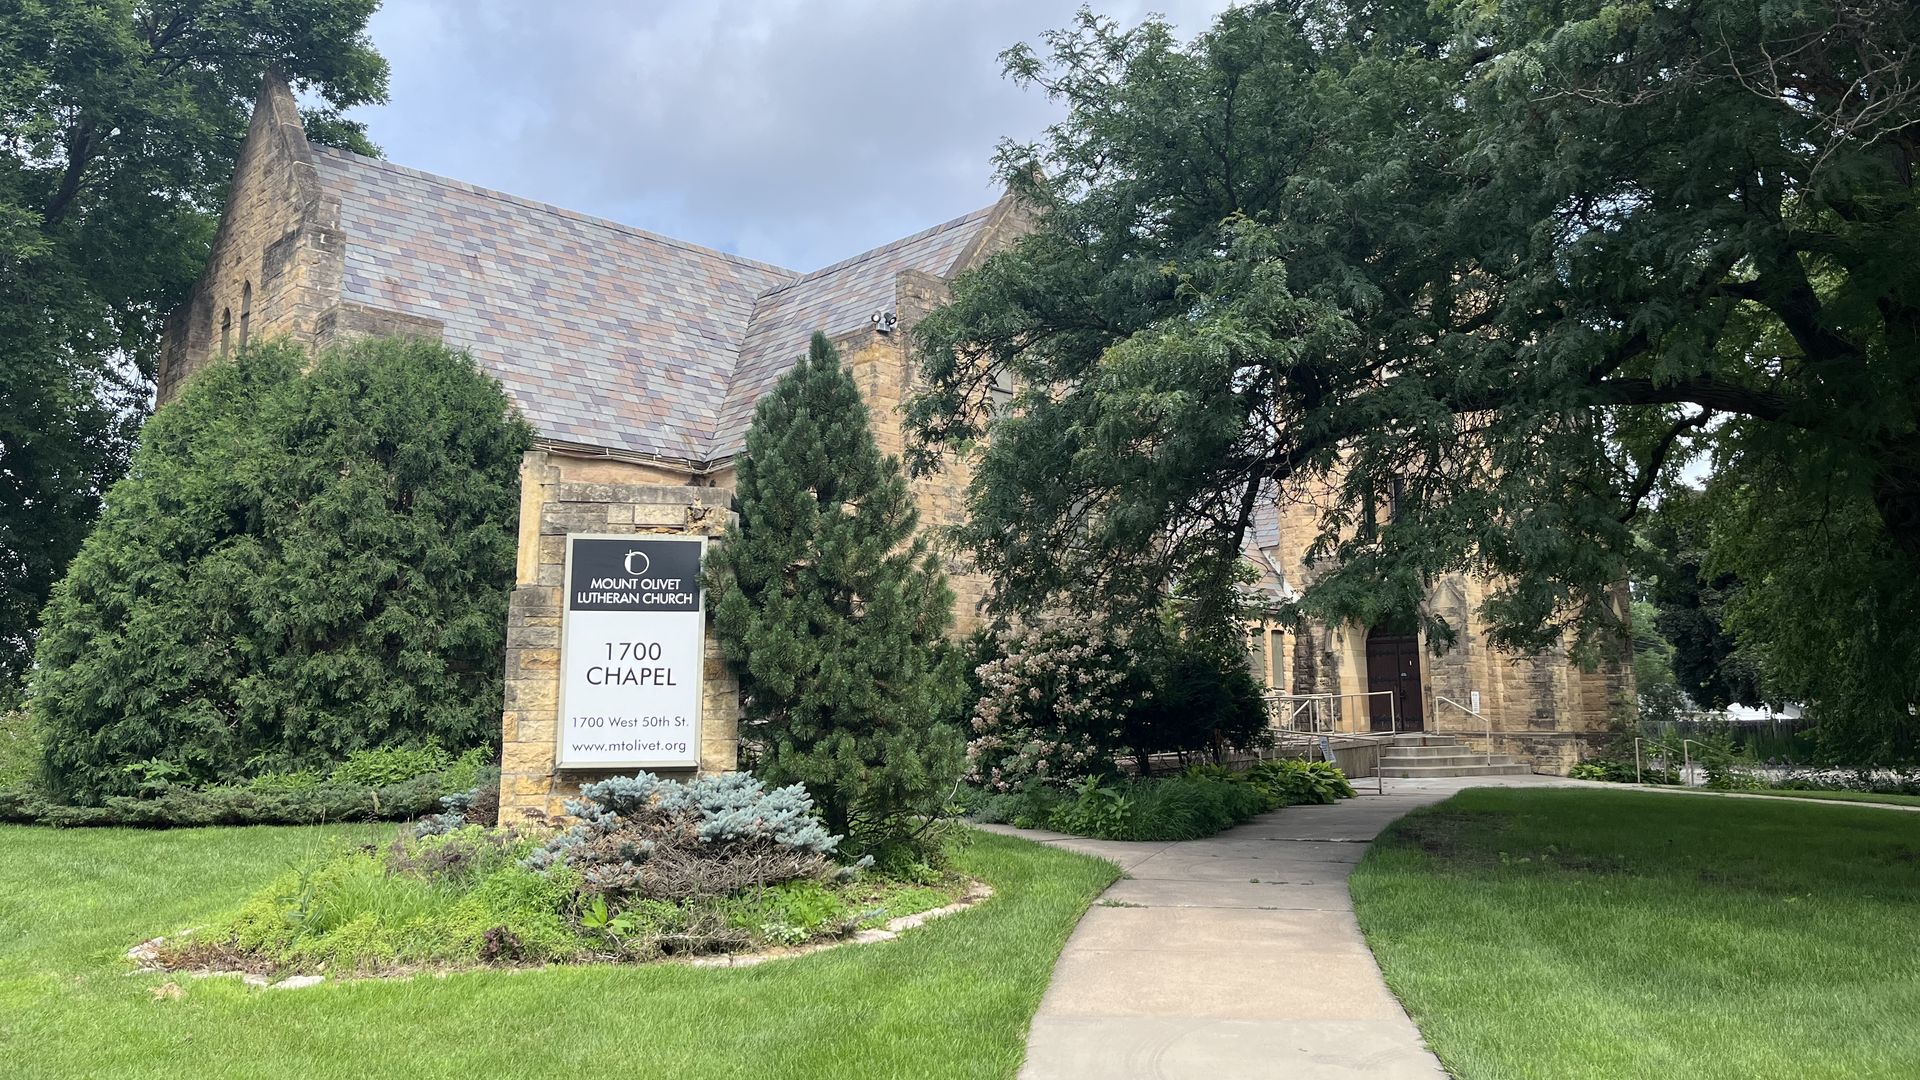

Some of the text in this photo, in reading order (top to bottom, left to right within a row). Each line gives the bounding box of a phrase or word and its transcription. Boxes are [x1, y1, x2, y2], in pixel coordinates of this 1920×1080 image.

[590, 577, 681, 590] MOUNT OLIVET
[577, 592, 693, 605] LUTHERAN CHURCH
[604, 642, 662, 661] 1700
[586, 666, 677, 686] CHAPEL
[572, 716, 689, 728] 1700 West 50th St.
[572, 739, 687, 753] www.mtolivet.org
